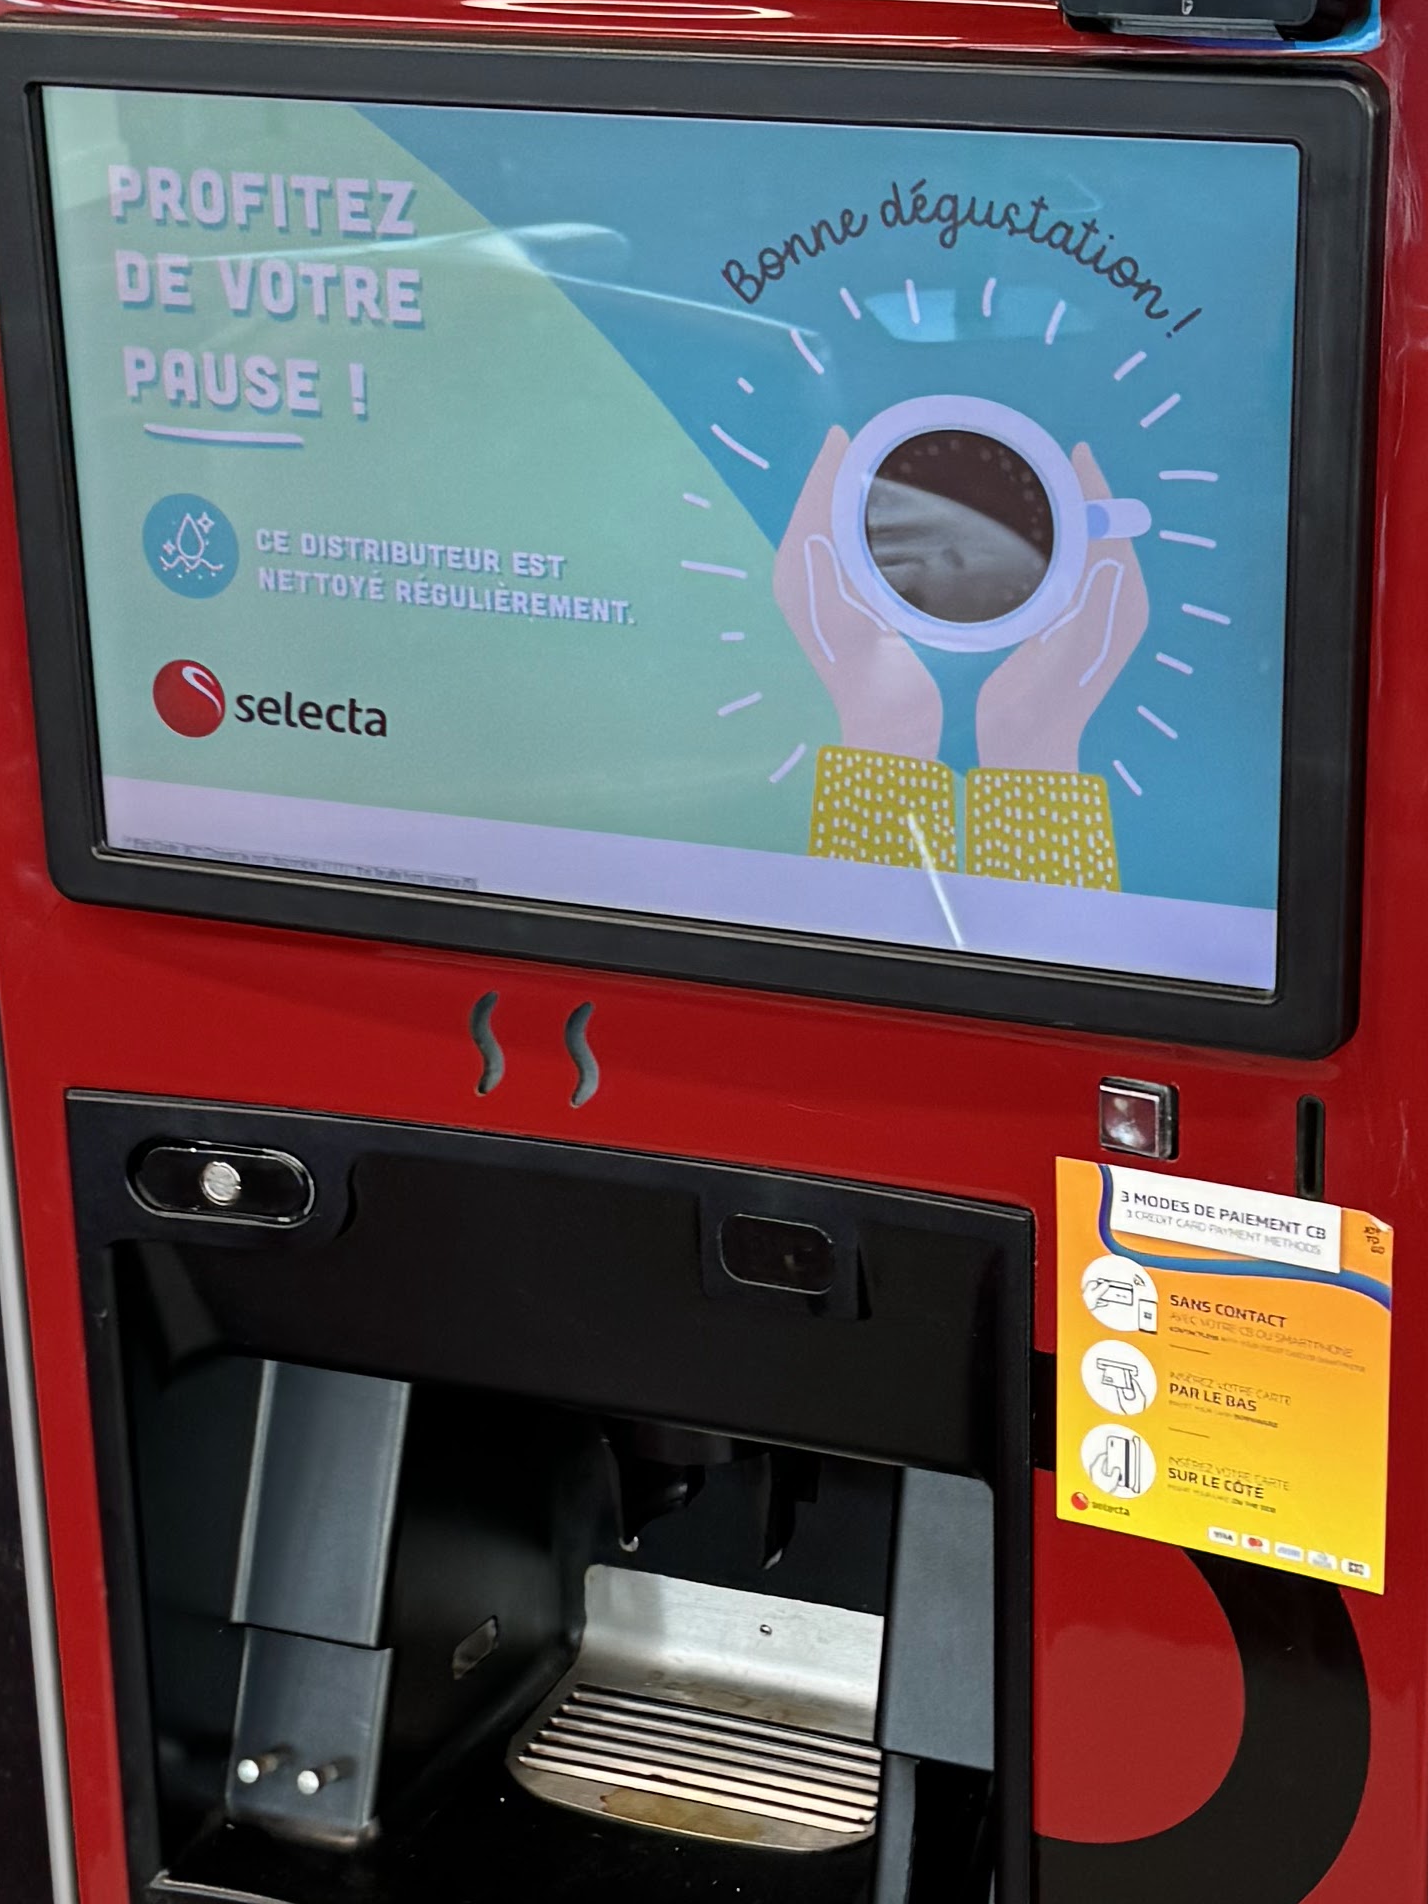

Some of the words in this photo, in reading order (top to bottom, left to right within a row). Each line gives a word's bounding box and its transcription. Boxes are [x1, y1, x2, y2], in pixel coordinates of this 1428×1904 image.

[109, 164, 417, 237] PROFITEZ
[721, 207, 868, 305] Bonne
[880, 178, 1170, 321] dégustation
[1165, 307, 1203, 339] !
[115, 249, 194, 312] DE
[218, 252, 425, 328] VOTRE
[122, 346, 322, 418] PAUSE
[348, 362, 369, 420] !
[256, 528, 291, 555] CE
[300, 533, 501, 575] DISTRIBUTEUR
[511, 551, 566, 580] EST
[258, 566, 385, 603] NETTOYÉ
[233, 692, 388, 738] selecta
[1133, 1193, 1190, 1214] MODES
[1195, 1203, 1215, 1218] DE
[1220, 1208, 1300, 1236] PAIEMENT
[1306, 1225, 1327, 1240] CB
[1170, 1294, 1212, 1313] SANS
[1215, 1303, 1287, 1328] CONTACT
[1169, 1382, 1199, 1400] PAR
[1203, 1390, 1222, 1405] LE
[1226, 1394, 1257, 1412] BAS
[1168, 1466, 1198, 1484] SUR
[1202, 1475, 1221, 1489] LE
